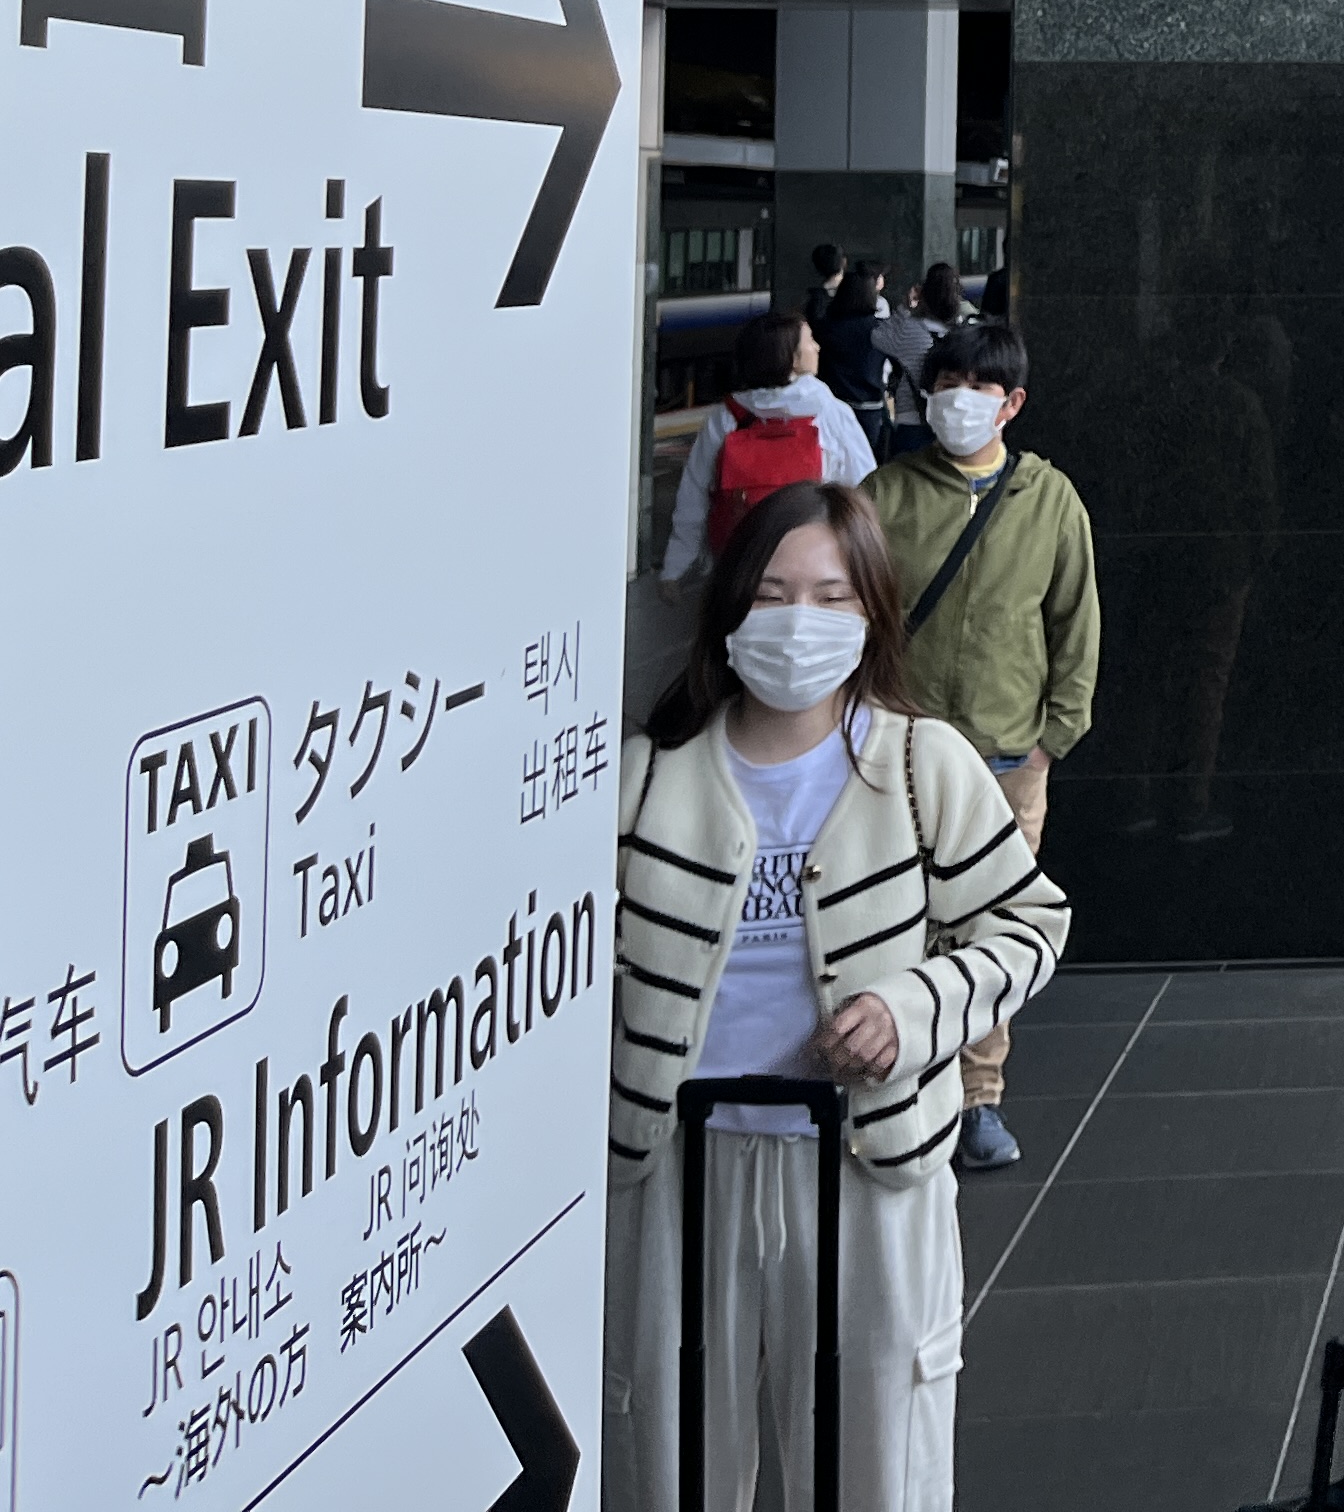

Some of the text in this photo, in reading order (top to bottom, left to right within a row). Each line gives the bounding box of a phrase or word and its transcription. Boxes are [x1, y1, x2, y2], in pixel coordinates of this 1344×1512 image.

[164, 178, 395, 449] Exit
[523, 620, 581, 716] 택시
[140, 717, 258, 834] TAXI
[293, 670, 486, 825] タクシー
[520, 711, 608, 825] 出租车
[293, 822, 376, 939] Taxi
[136, 889, 596, 1322] JR Information
[363, 1088, 481, 1241] JR 问询处
[142, 1240, 293, 1418] JR 안내소
